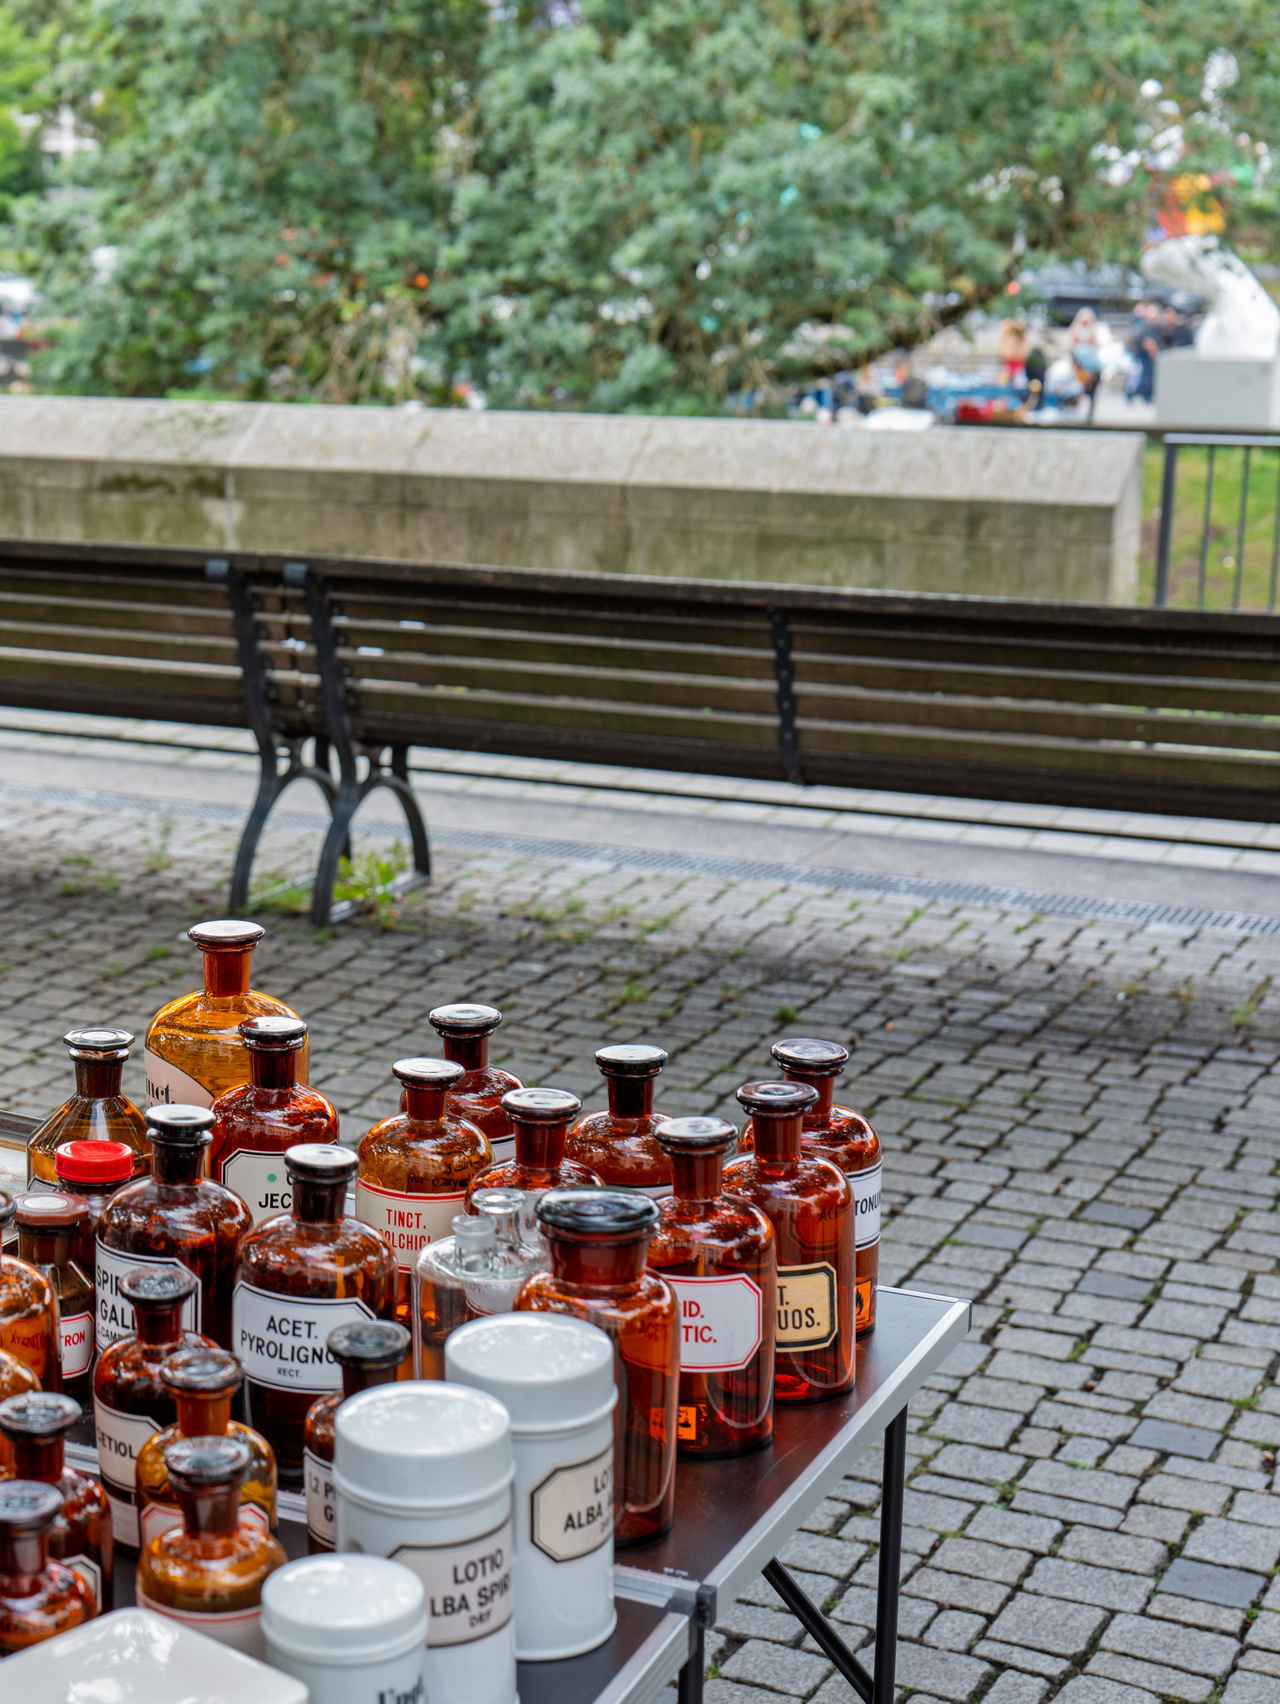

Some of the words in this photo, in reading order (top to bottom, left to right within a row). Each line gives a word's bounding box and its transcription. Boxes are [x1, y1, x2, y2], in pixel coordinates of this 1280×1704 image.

[385, 1208, 427, 1230] TINCT.
[61, 1329, 86, 1347] RON
[266, 1315, 318, 1340] ACET.
[562, 1501, 604, 1534] ALBA
[452, 1547, 505, 1586] LOTIO
